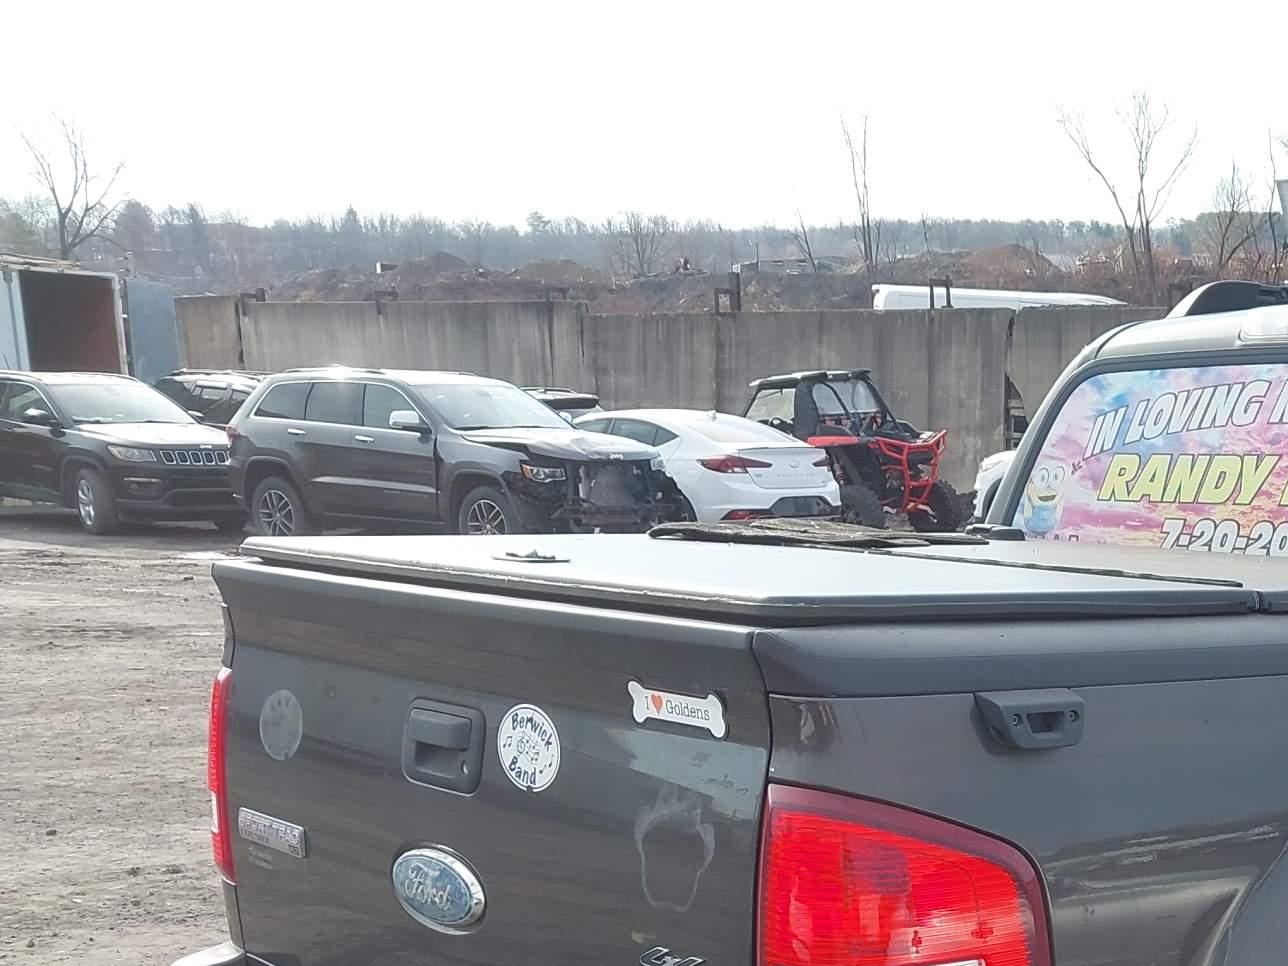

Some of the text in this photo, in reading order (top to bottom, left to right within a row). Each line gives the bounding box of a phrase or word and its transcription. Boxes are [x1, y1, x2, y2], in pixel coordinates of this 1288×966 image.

[1082, 405, 1128, 460] IN
[1123, 379, 1272, 445] LOVING
[1097, 453, 1279, 506] RANDY
[644, 696, 710, 720] I Goldens
[511, 712, 553, 752] Berwick
[508, 755, 537, 785] Band
[404, 862, 453, 911] Ford
